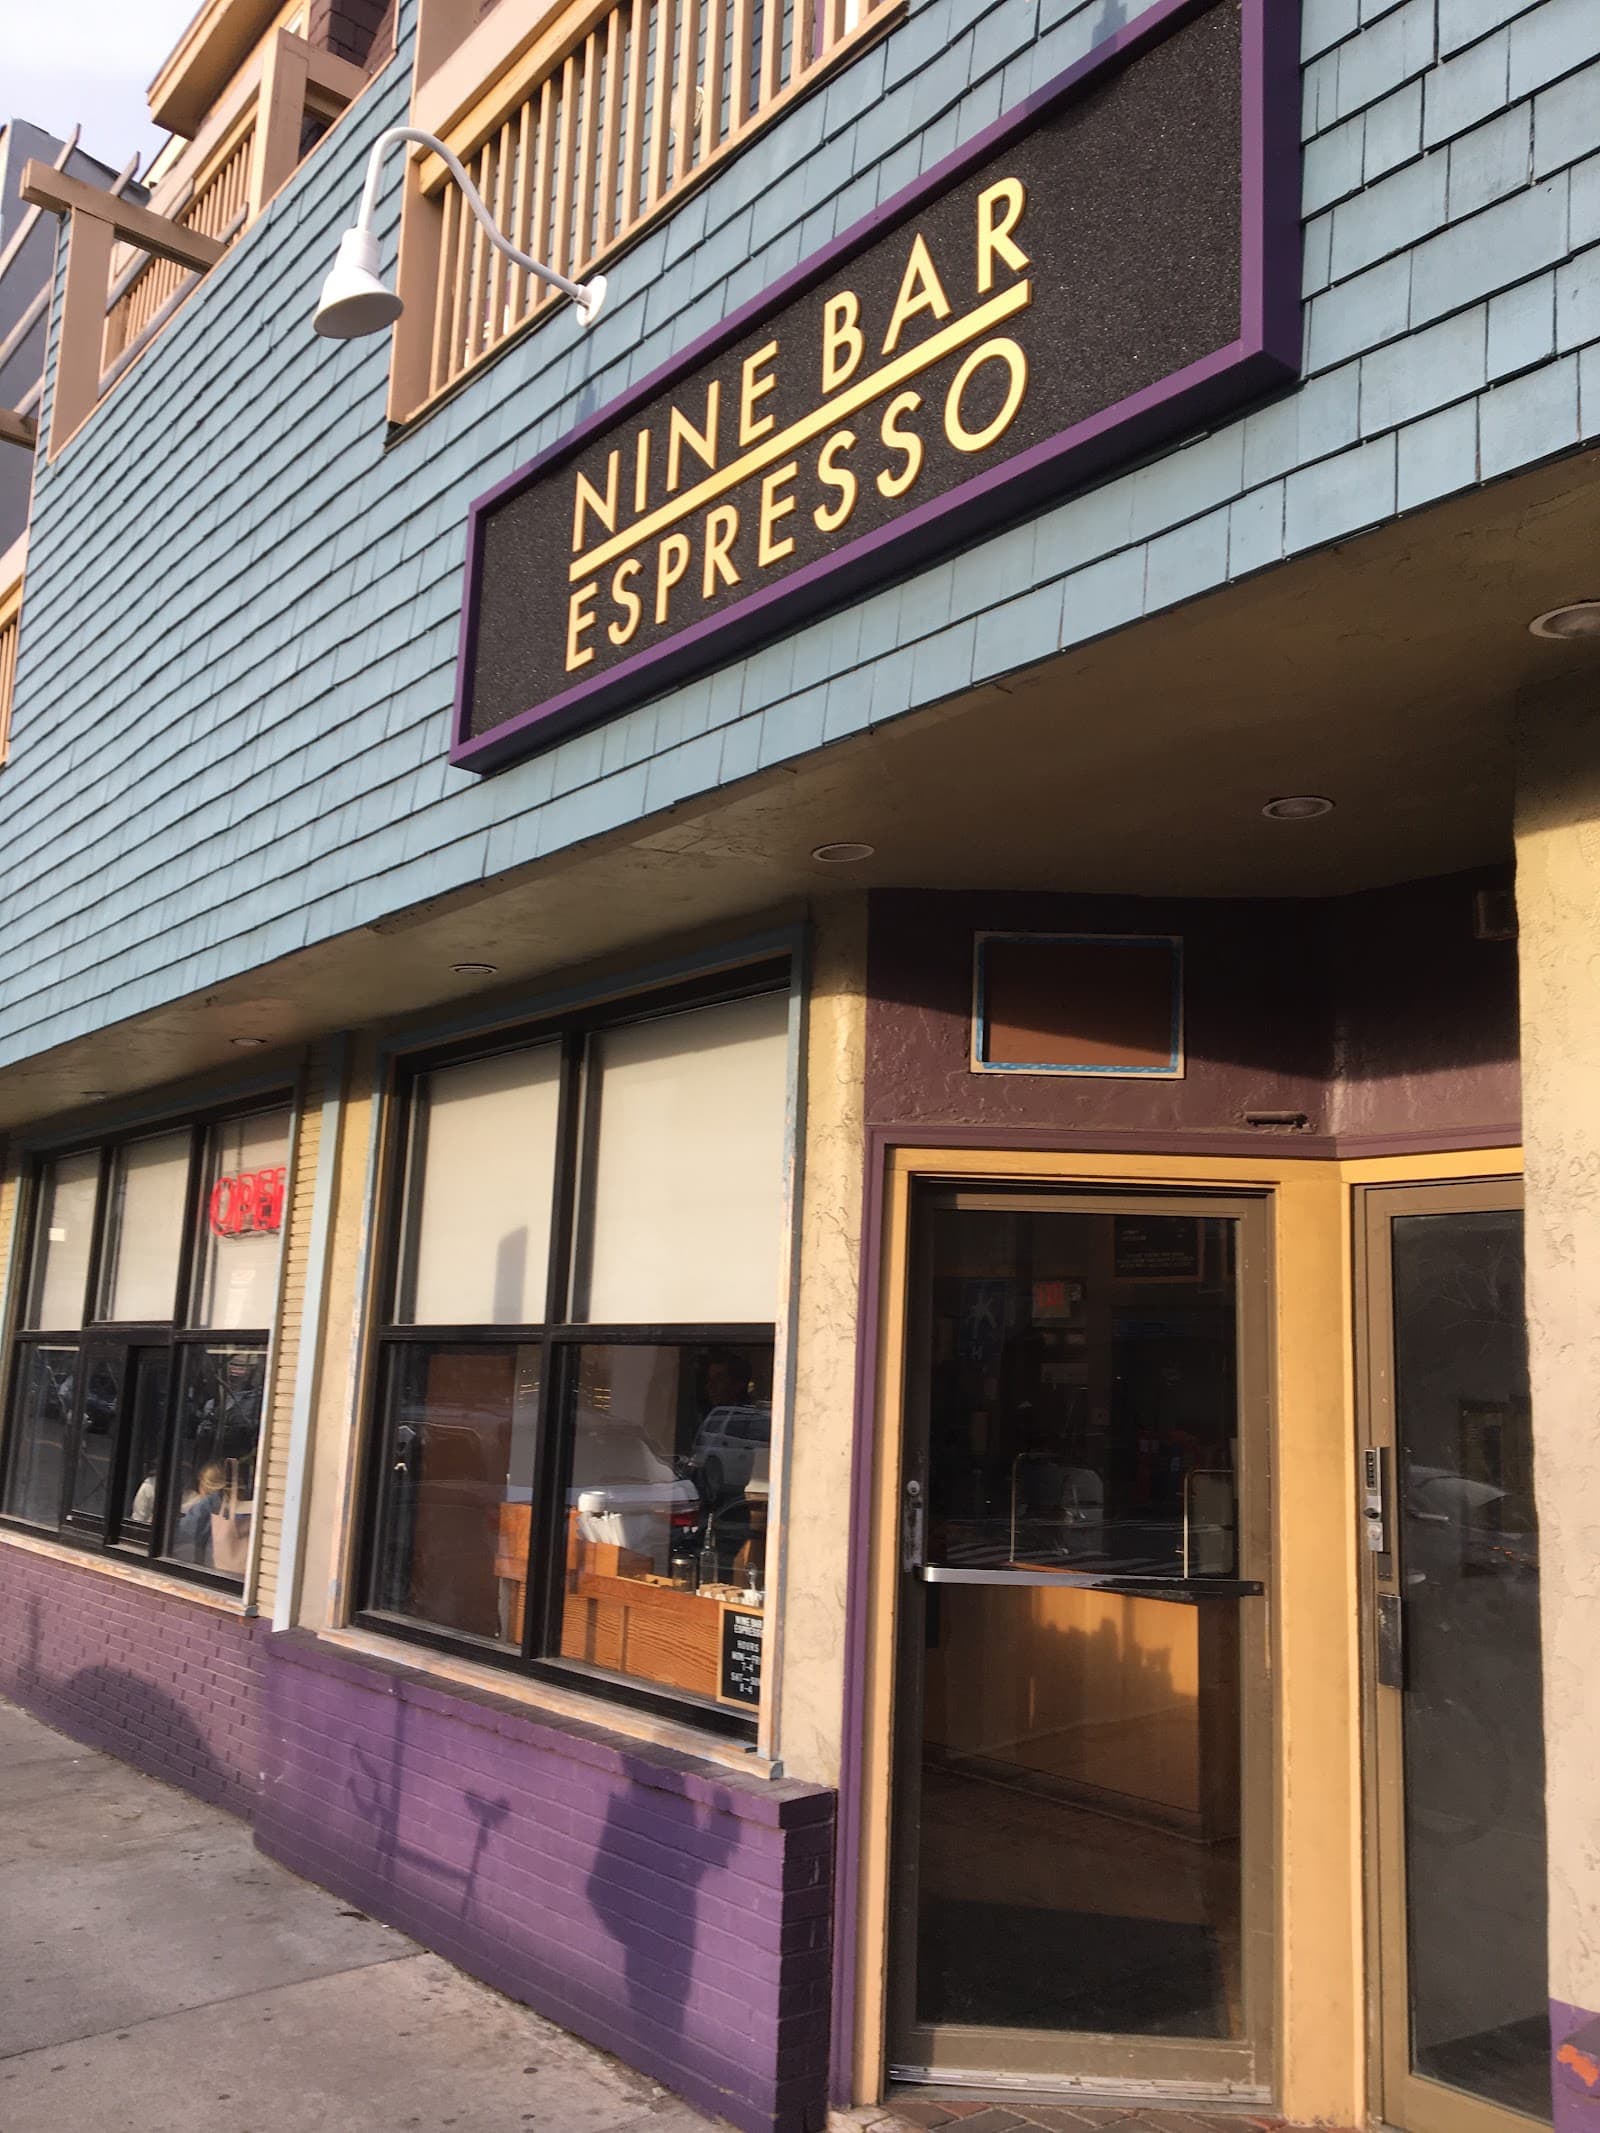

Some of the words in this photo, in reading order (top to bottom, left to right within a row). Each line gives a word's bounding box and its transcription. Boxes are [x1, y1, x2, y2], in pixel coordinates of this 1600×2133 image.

[565, 337, 1029, 672] ESPRESSO
[572, 340, 779, 553] NINE
[821, 176, 1031, 395] BAR
[737, 1640, 759, 1652] HOURS
